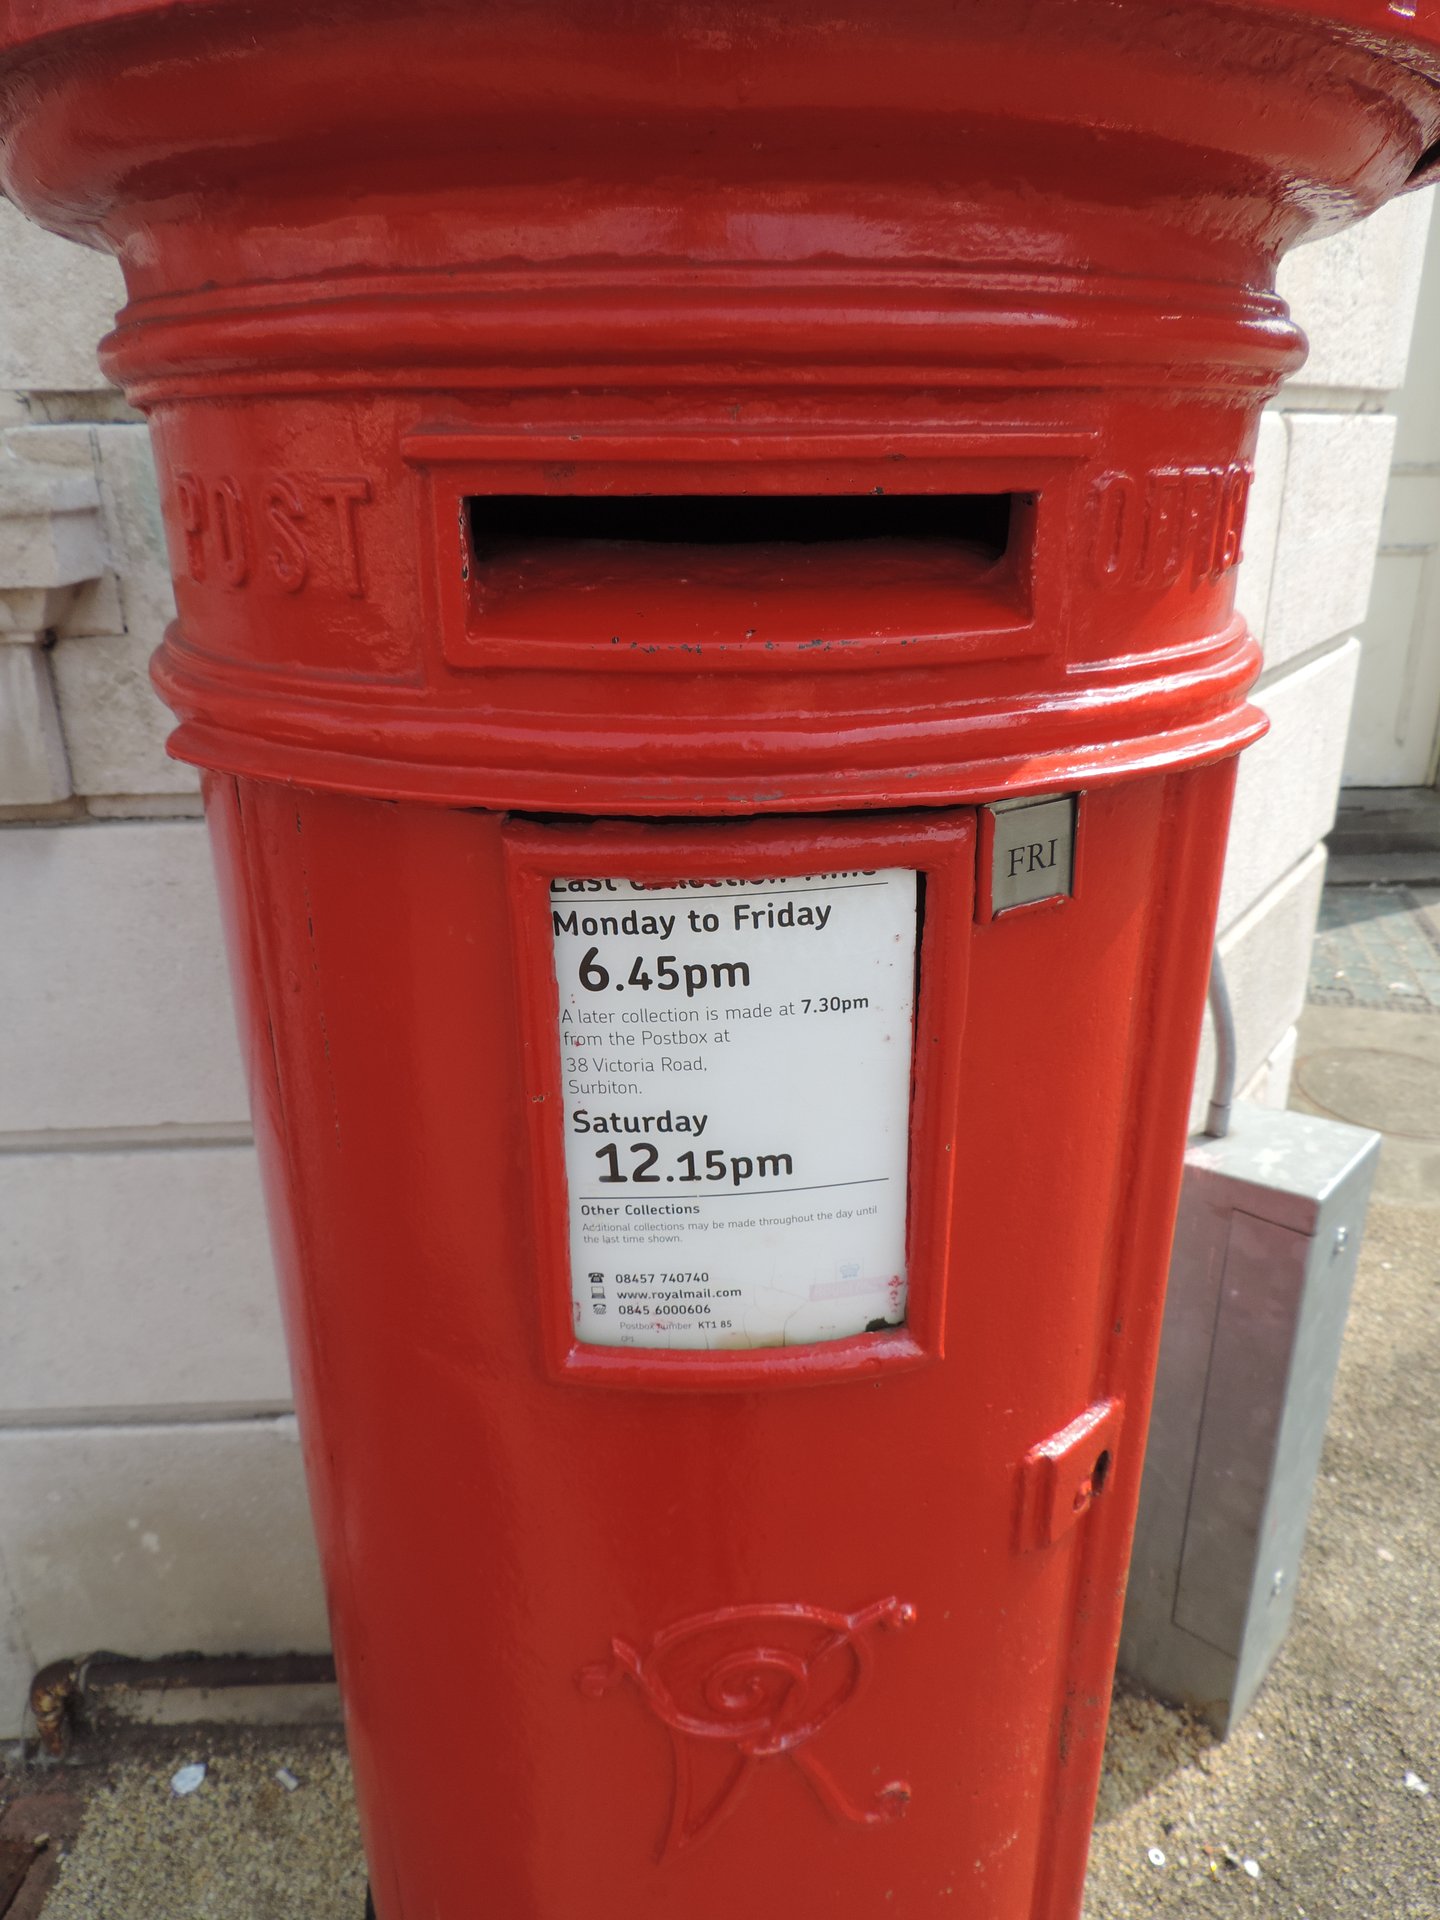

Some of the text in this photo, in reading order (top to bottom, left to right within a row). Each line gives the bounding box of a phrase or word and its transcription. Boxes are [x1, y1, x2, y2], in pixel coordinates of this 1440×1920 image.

[173, 471, 372, 600] POST
[1007, 838, 1058, 878] FRI
[552, 902, 832, 940] Monday to Friday
[578, 946, 750, 997] 6.45pm
[562, 996, 869, 1024] A later collection is made at 7.30pm
[564, 1028, 730, 1046] from the Postbox at
[567, 1056, 708, 1073] 38 Victoria Road,
[568, 1078, 643, 1095] Surbiton.
[573, 1109, 708, 1137] Saturday
[595, 1142, 794, 1187] 12.15pm
[581, 1203, 700, 1216] Other Collections
[634, 1221, 684, 1232] collections
[688, 1221, 709, 1232] may
[712, 1220, 724, 1230] be
[728, 1218, 756, 1229] made
[759, 1213, 814, 1226] throughout
[817, 1211, 833, 1220] the
[836, 1208, 853, 1219] day
[856, 1205, 878, 1217] until
[583, 1233, 683, 1244] the last time shown.
[615, 1272, 709, 1284] 08457 740740
[617, 1288, 742, 1302] www.royalmail.com
[619, 1304, 711, 1316] 0845 6000606
[698, 1321, 717, 1330] KT1
[720, 1320, 733, 1329] 85
